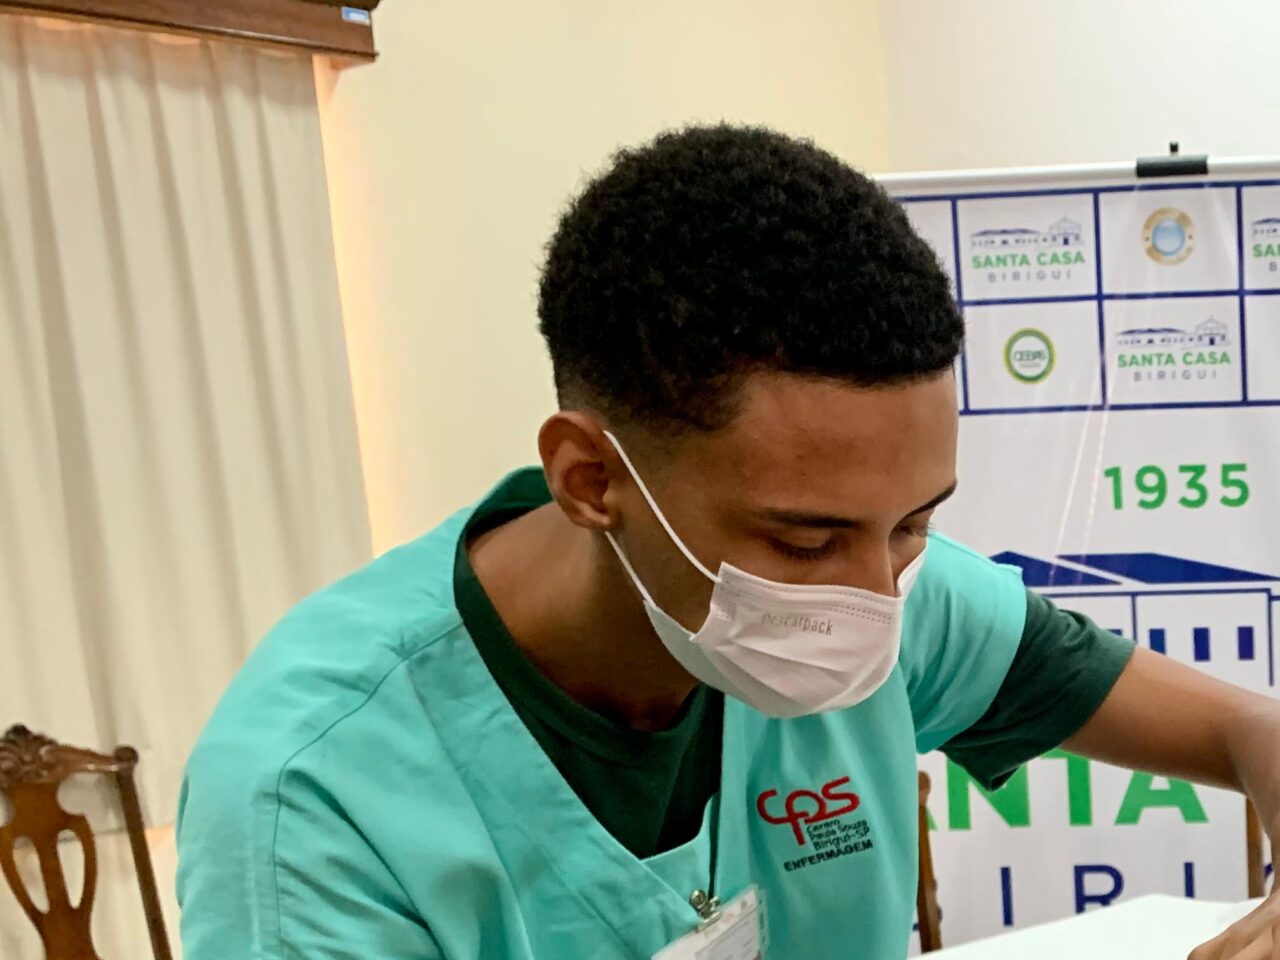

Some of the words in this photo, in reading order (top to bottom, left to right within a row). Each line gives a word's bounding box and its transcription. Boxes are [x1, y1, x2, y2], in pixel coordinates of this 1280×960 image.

[972, 253, 1030, 270] SANTA
[1036, 250, 1085, 266] CASA
[987, 269, 1071, 283] BIRIGUI
[1117, 351, 1176, 369] SANTA
[1181, 350, 1232, 365] CASA
[1133, 369, 1217, 382] BIRIGUI
[1103, 462, 1252, 511] 1935
[927, 747, 1210, 831] NTA
[783, 838, 874, 872] ENFERMAGEM
